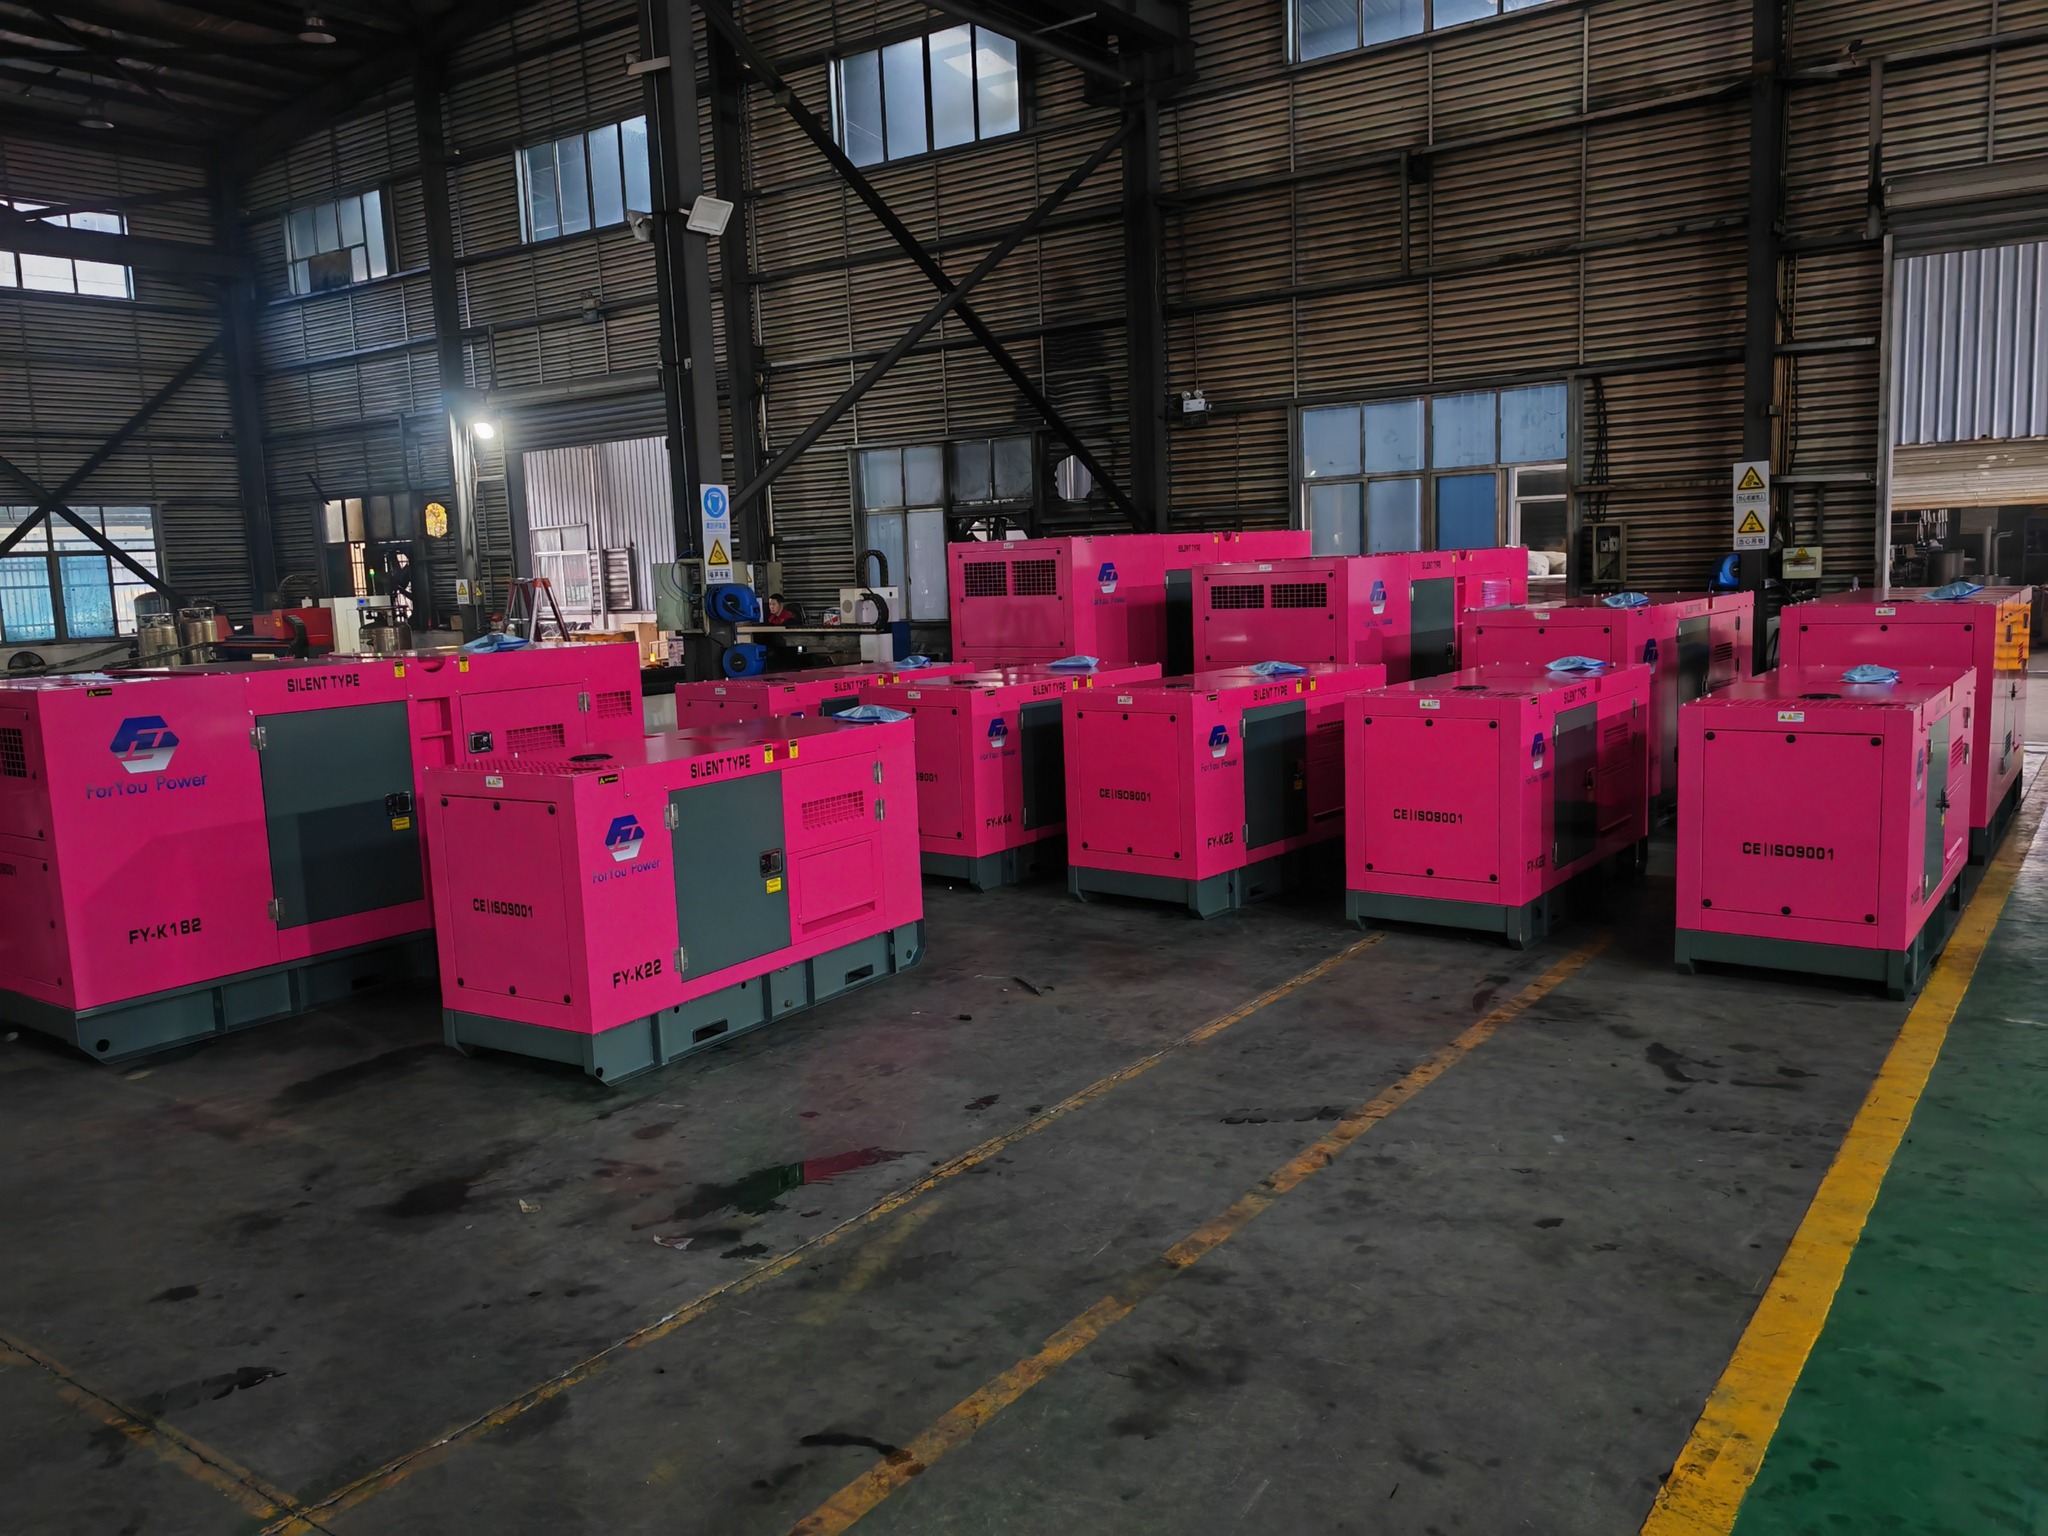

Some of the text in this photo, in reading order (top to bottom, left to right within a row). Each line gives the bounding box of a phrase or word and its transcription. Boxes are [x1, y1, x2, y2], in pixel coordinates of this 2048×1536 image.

[287, 673, 360, 692] SILENT TYPE
[834, 681, 855, 692] SILENT
[1033, 681, 1066, 695] SILENT TYPE
[1253, 684, 1288, 701] SILENT TYPE
[690, 753, 751, 779] SILENT TYPE
[86, 774, 208, 800] ForYou Power
[986, 813, 1013, 829] FY-K44
[1207, 831, 1234, 849] FY-K22
[631, 859, 661, 874] Power
[129, 917, 202, 945] FY-K182
[612, 958, 662, 988] FY-K22
